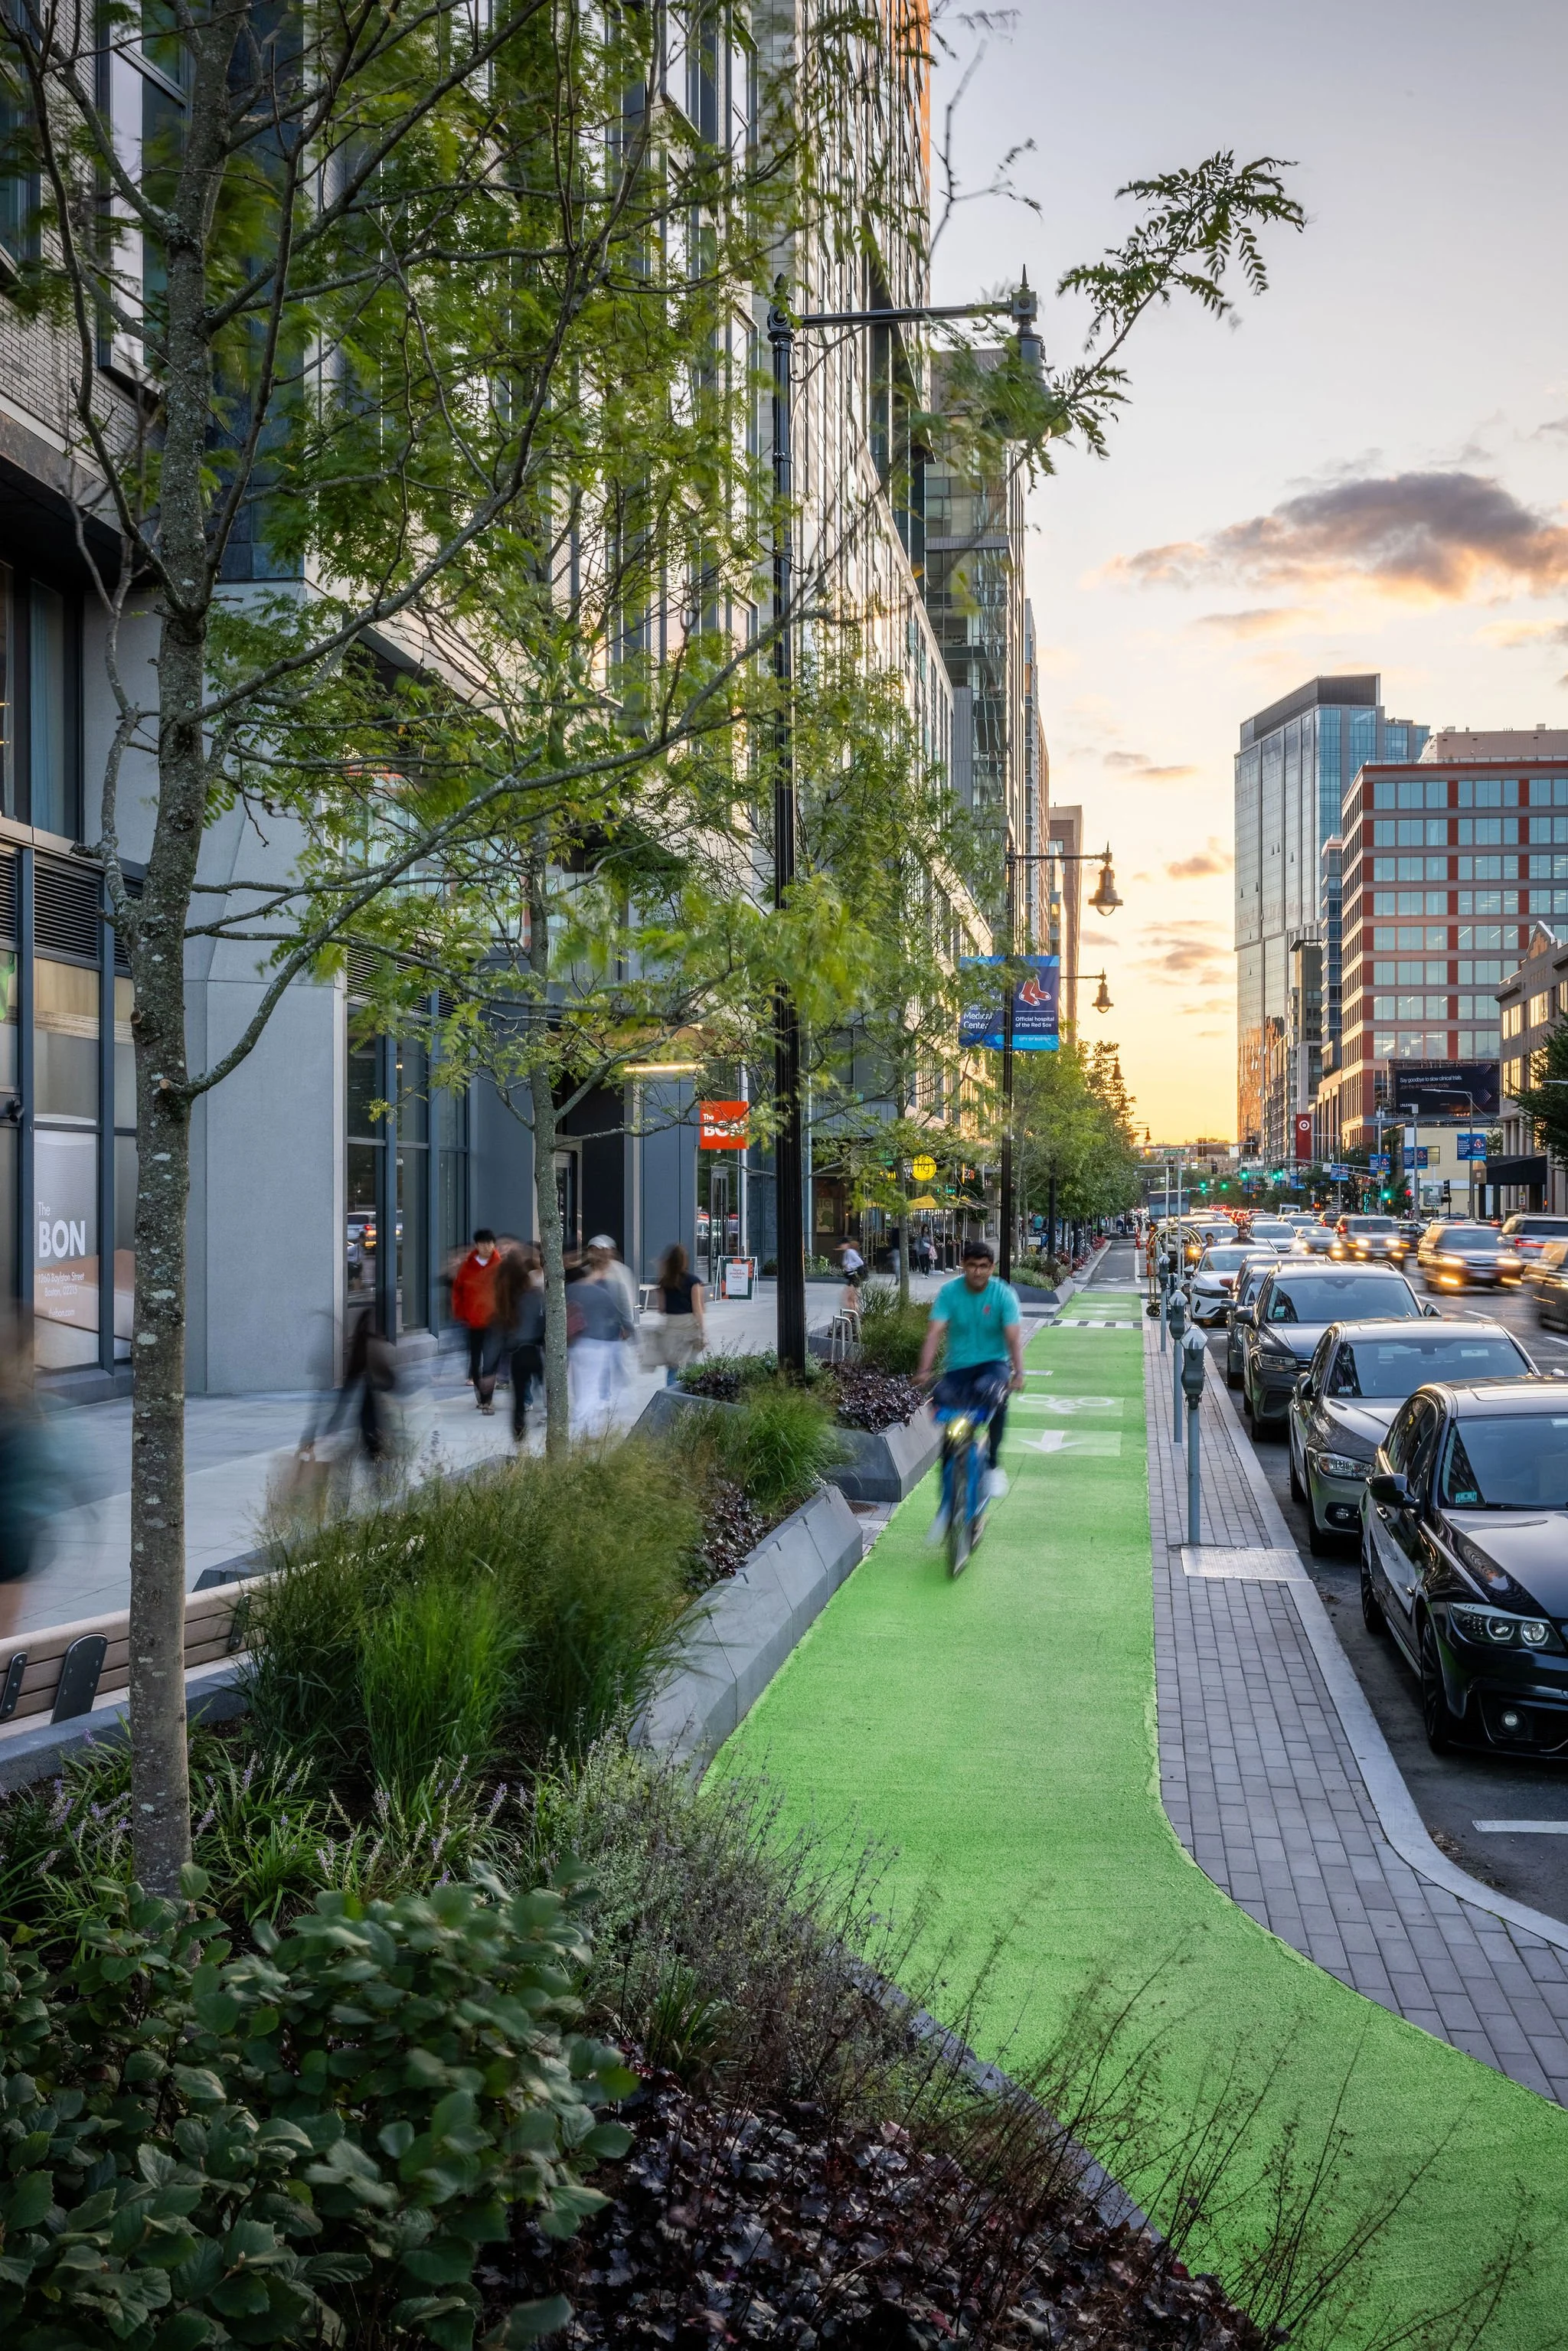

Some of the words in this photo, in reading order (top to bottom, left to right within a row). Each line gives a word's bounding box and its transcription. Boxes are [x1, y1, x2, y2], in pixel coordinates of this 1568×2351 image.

[38, 1202, 51, 1216] The
[38, 1220, 86, 1258] BON
[51, 1271, 70, 1285] Boylston
[71, 1271, 85, 1282] Street
